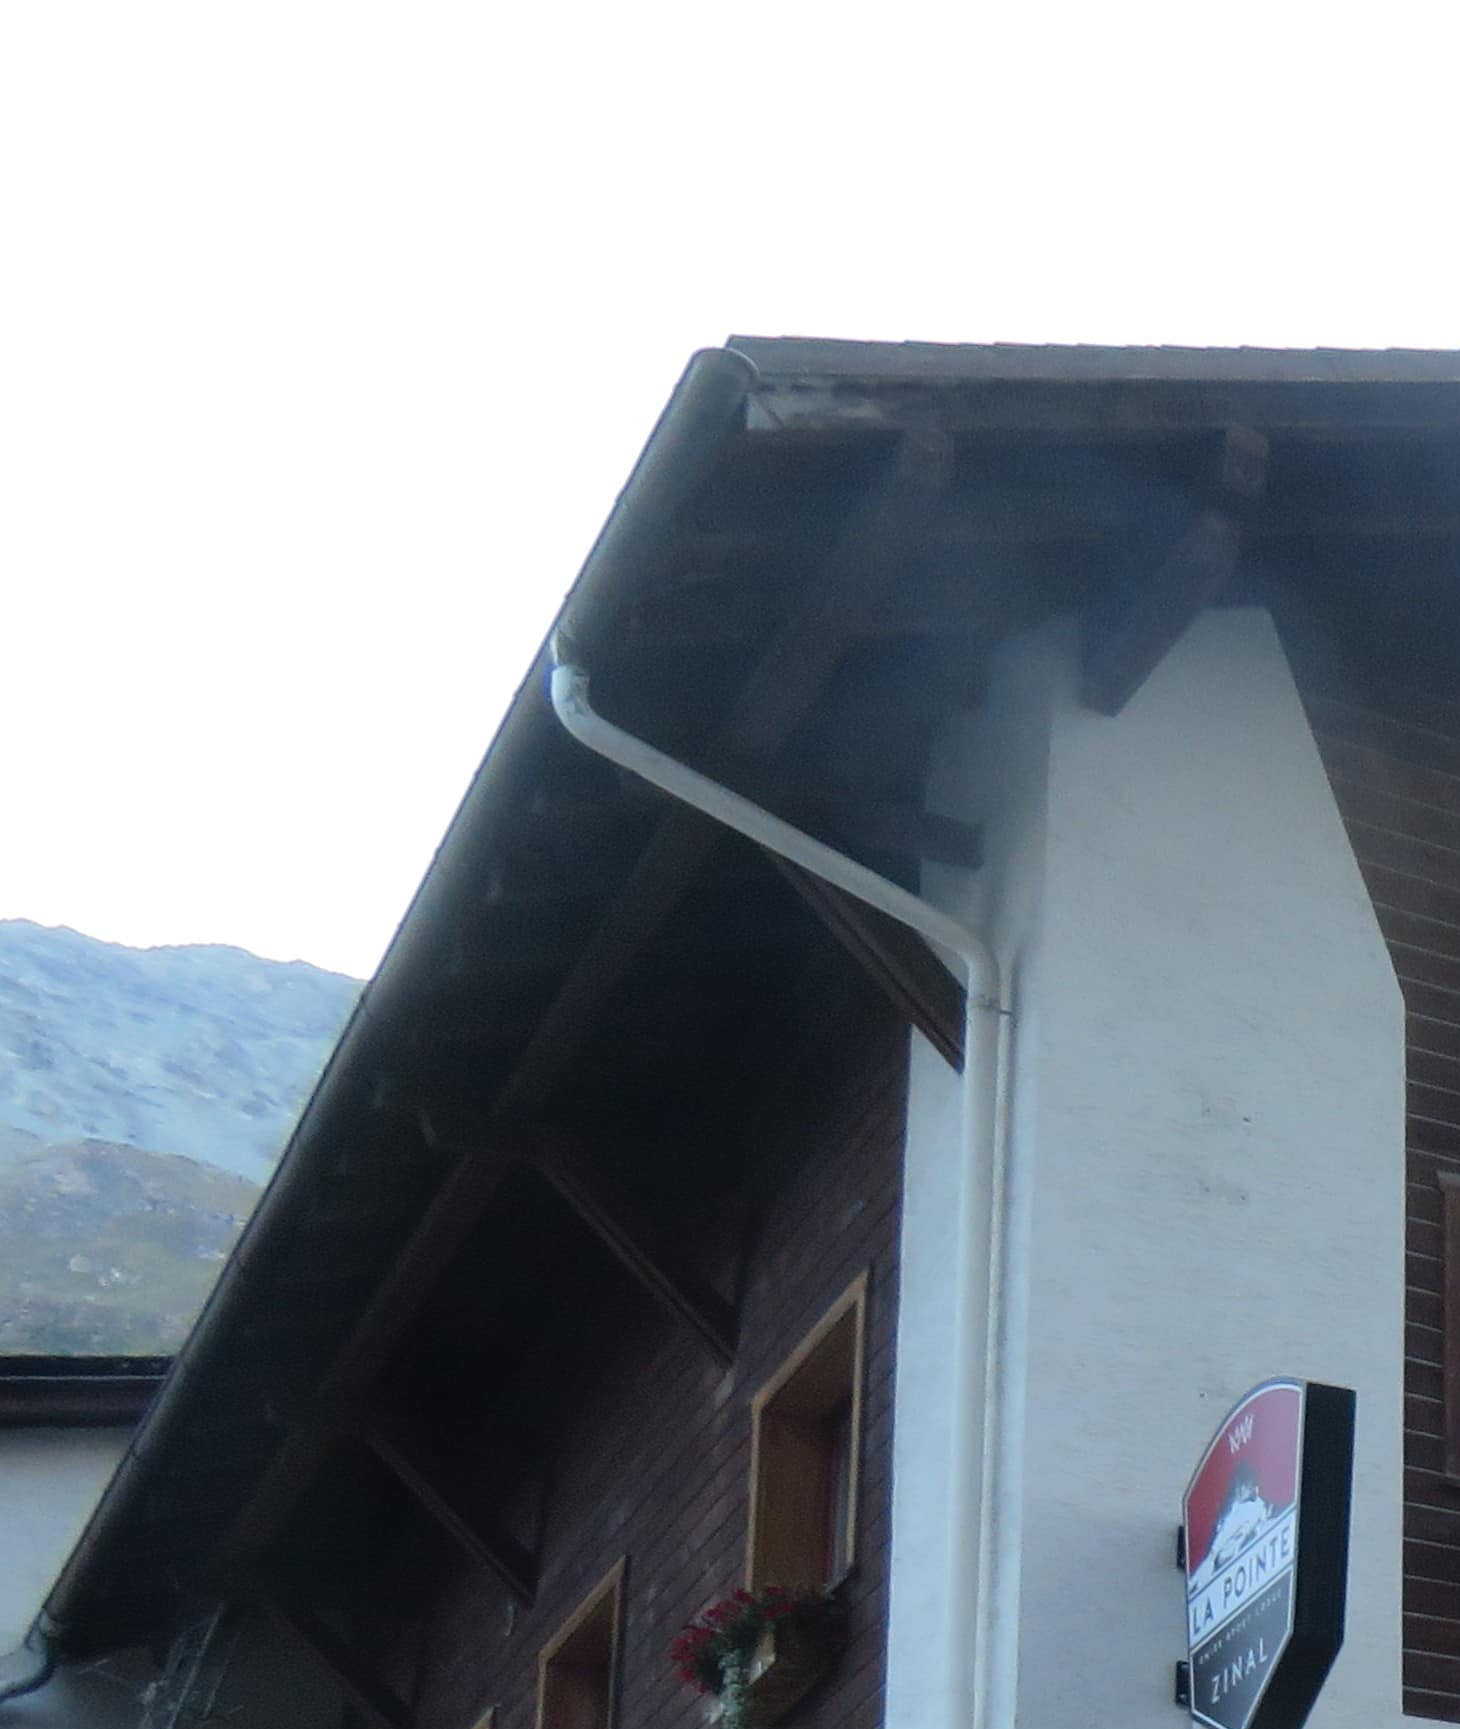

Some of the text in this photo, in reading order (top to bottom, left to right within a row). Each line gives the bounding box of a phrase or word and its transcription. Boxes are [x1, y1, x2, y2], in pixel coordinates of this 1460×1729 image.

[1192, 1595, 1214, 1635] LA
[1223, 1527, 1291, 1609] POINTE
[1211, 1637, 1267, 1704] ZINAL
